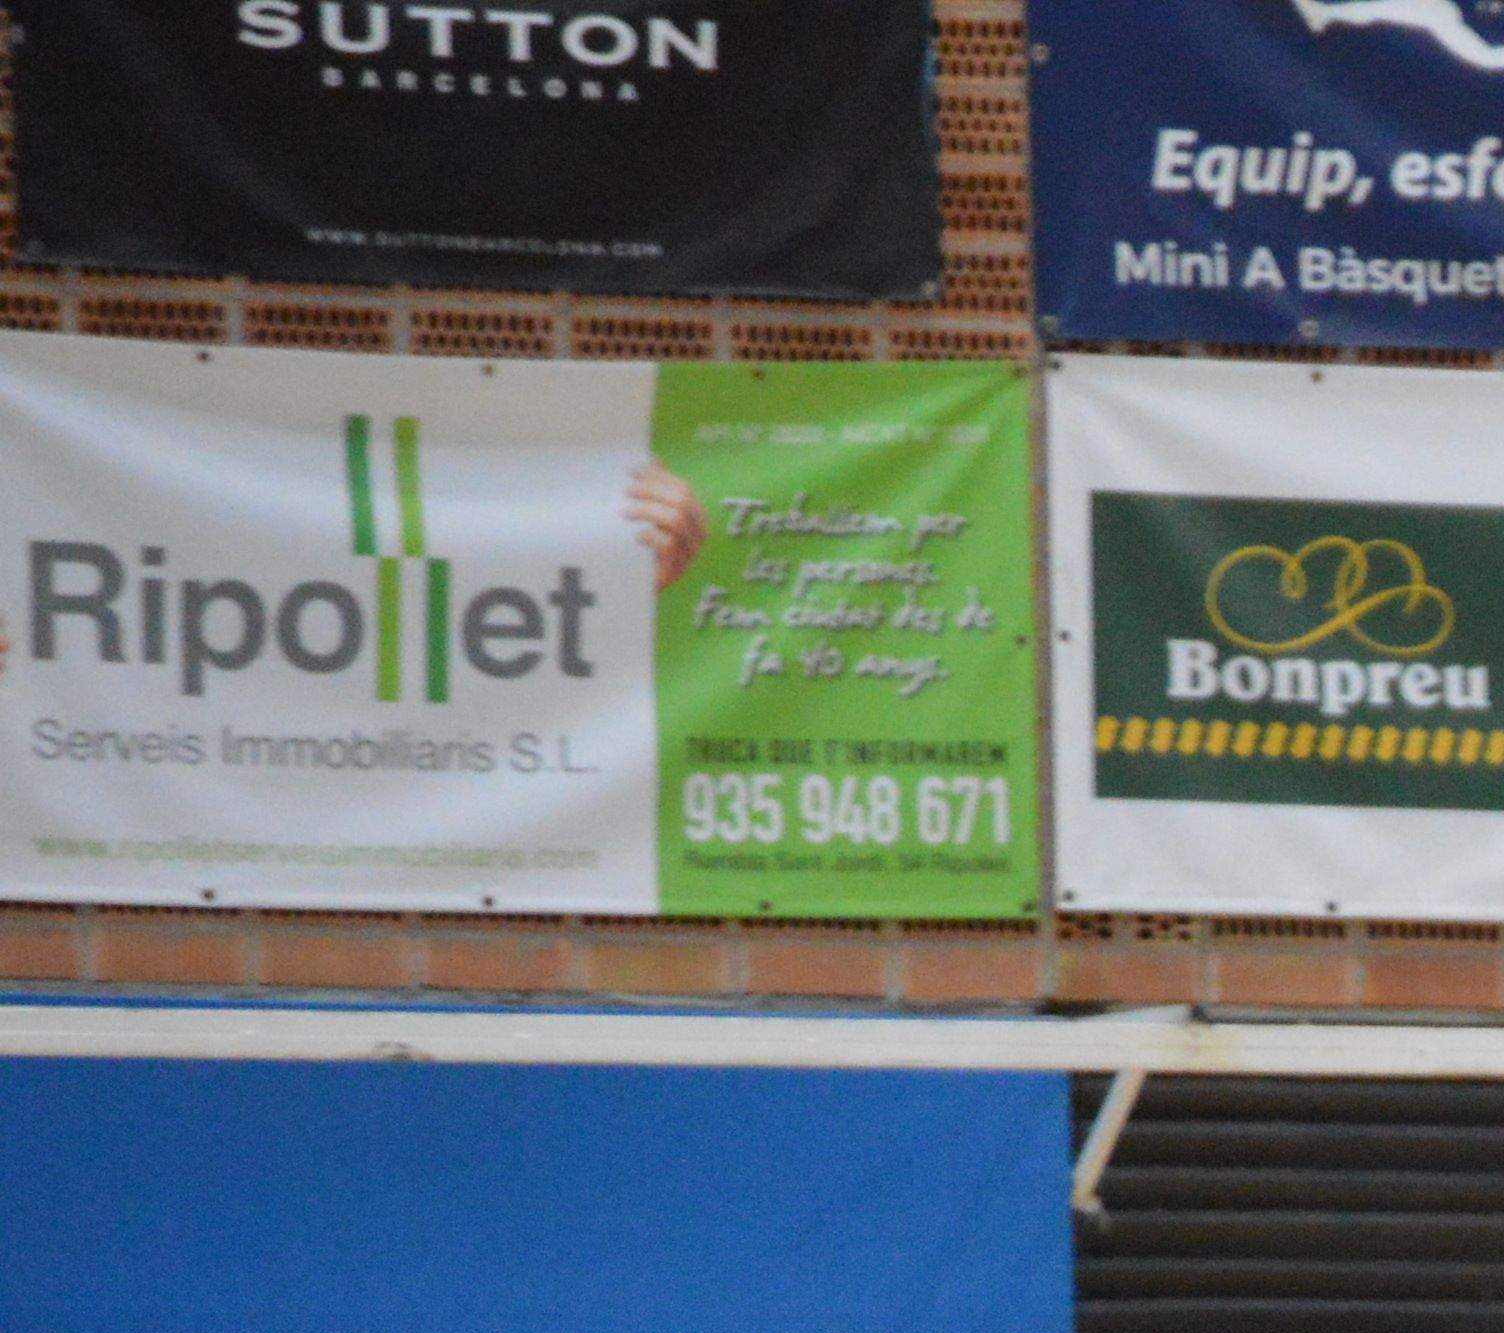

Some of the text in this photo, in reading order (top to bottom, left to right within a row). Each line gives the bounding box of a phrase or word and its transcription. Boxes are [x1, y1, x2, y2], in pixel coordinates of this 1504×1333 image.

[236, 0, 718, 69] SUTTON
[321, 66, 641, 101] BARCELONA
[1152, 127, 1374, 211] Equip,
[1114, 241, 1229, 288] Mini
[1243, 245, 1286, 291] A
[27, 475, 598, 702] Ripollet
[1167, 637, 1492, 717] Bonpreu
[33, 718, 207, 766] Serveis
[509, 731, 601, 774] S.L.
[684, 773, 1010, 846] 935 948 671
